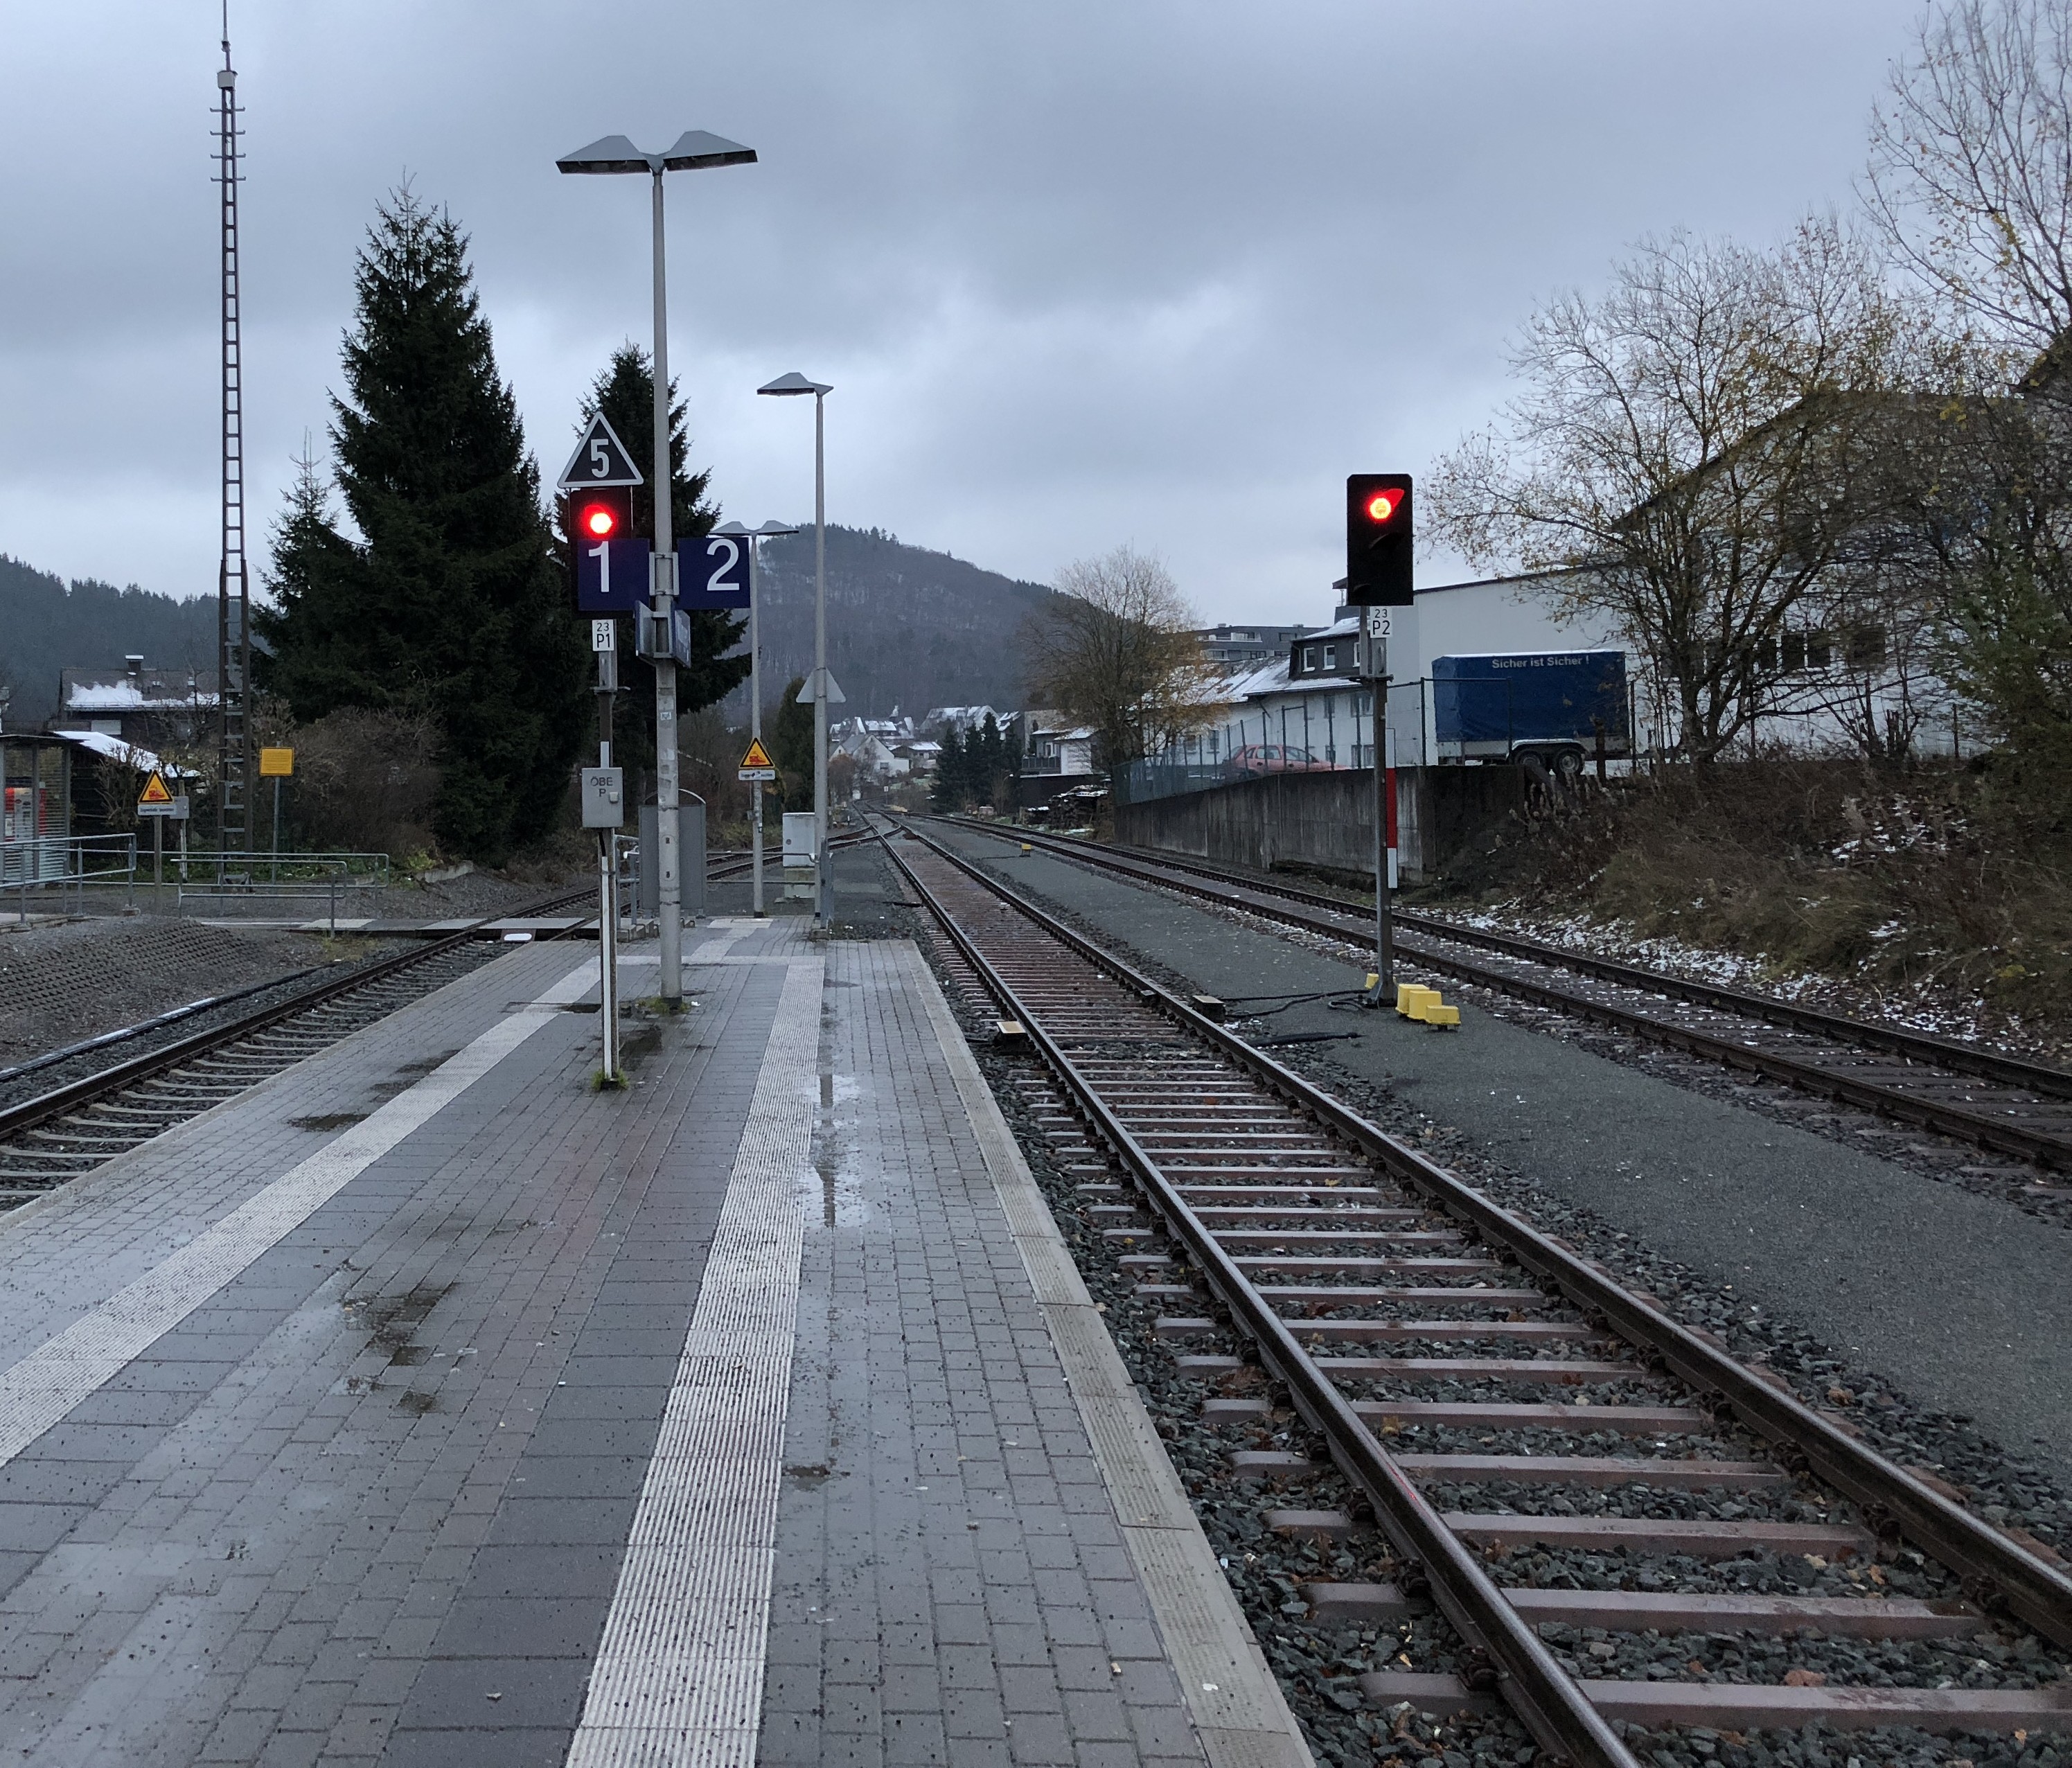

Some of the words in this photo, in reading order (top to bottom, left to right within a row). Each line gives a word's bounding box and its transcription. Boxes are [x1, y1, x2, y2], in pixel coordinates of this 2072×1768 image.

[590, 439, 610, 478] 5
[588, 541, 610, 593] 1
[707, 539, 740, 591] 2
[1374, 608, 1388, 618] 23
[596, 622, 610, 632] 23
[1372, 620, 1390, 635] P2
[596, 633, 610, 648] P1
[1491, 659, 1528, 669] Sicher
[1530, 657, 1544, 667] ist
[1547, 656, 1582, 666] Sicher
[590, 776, 613, 786] ÖBE
[599, 788, 607, 797] P
